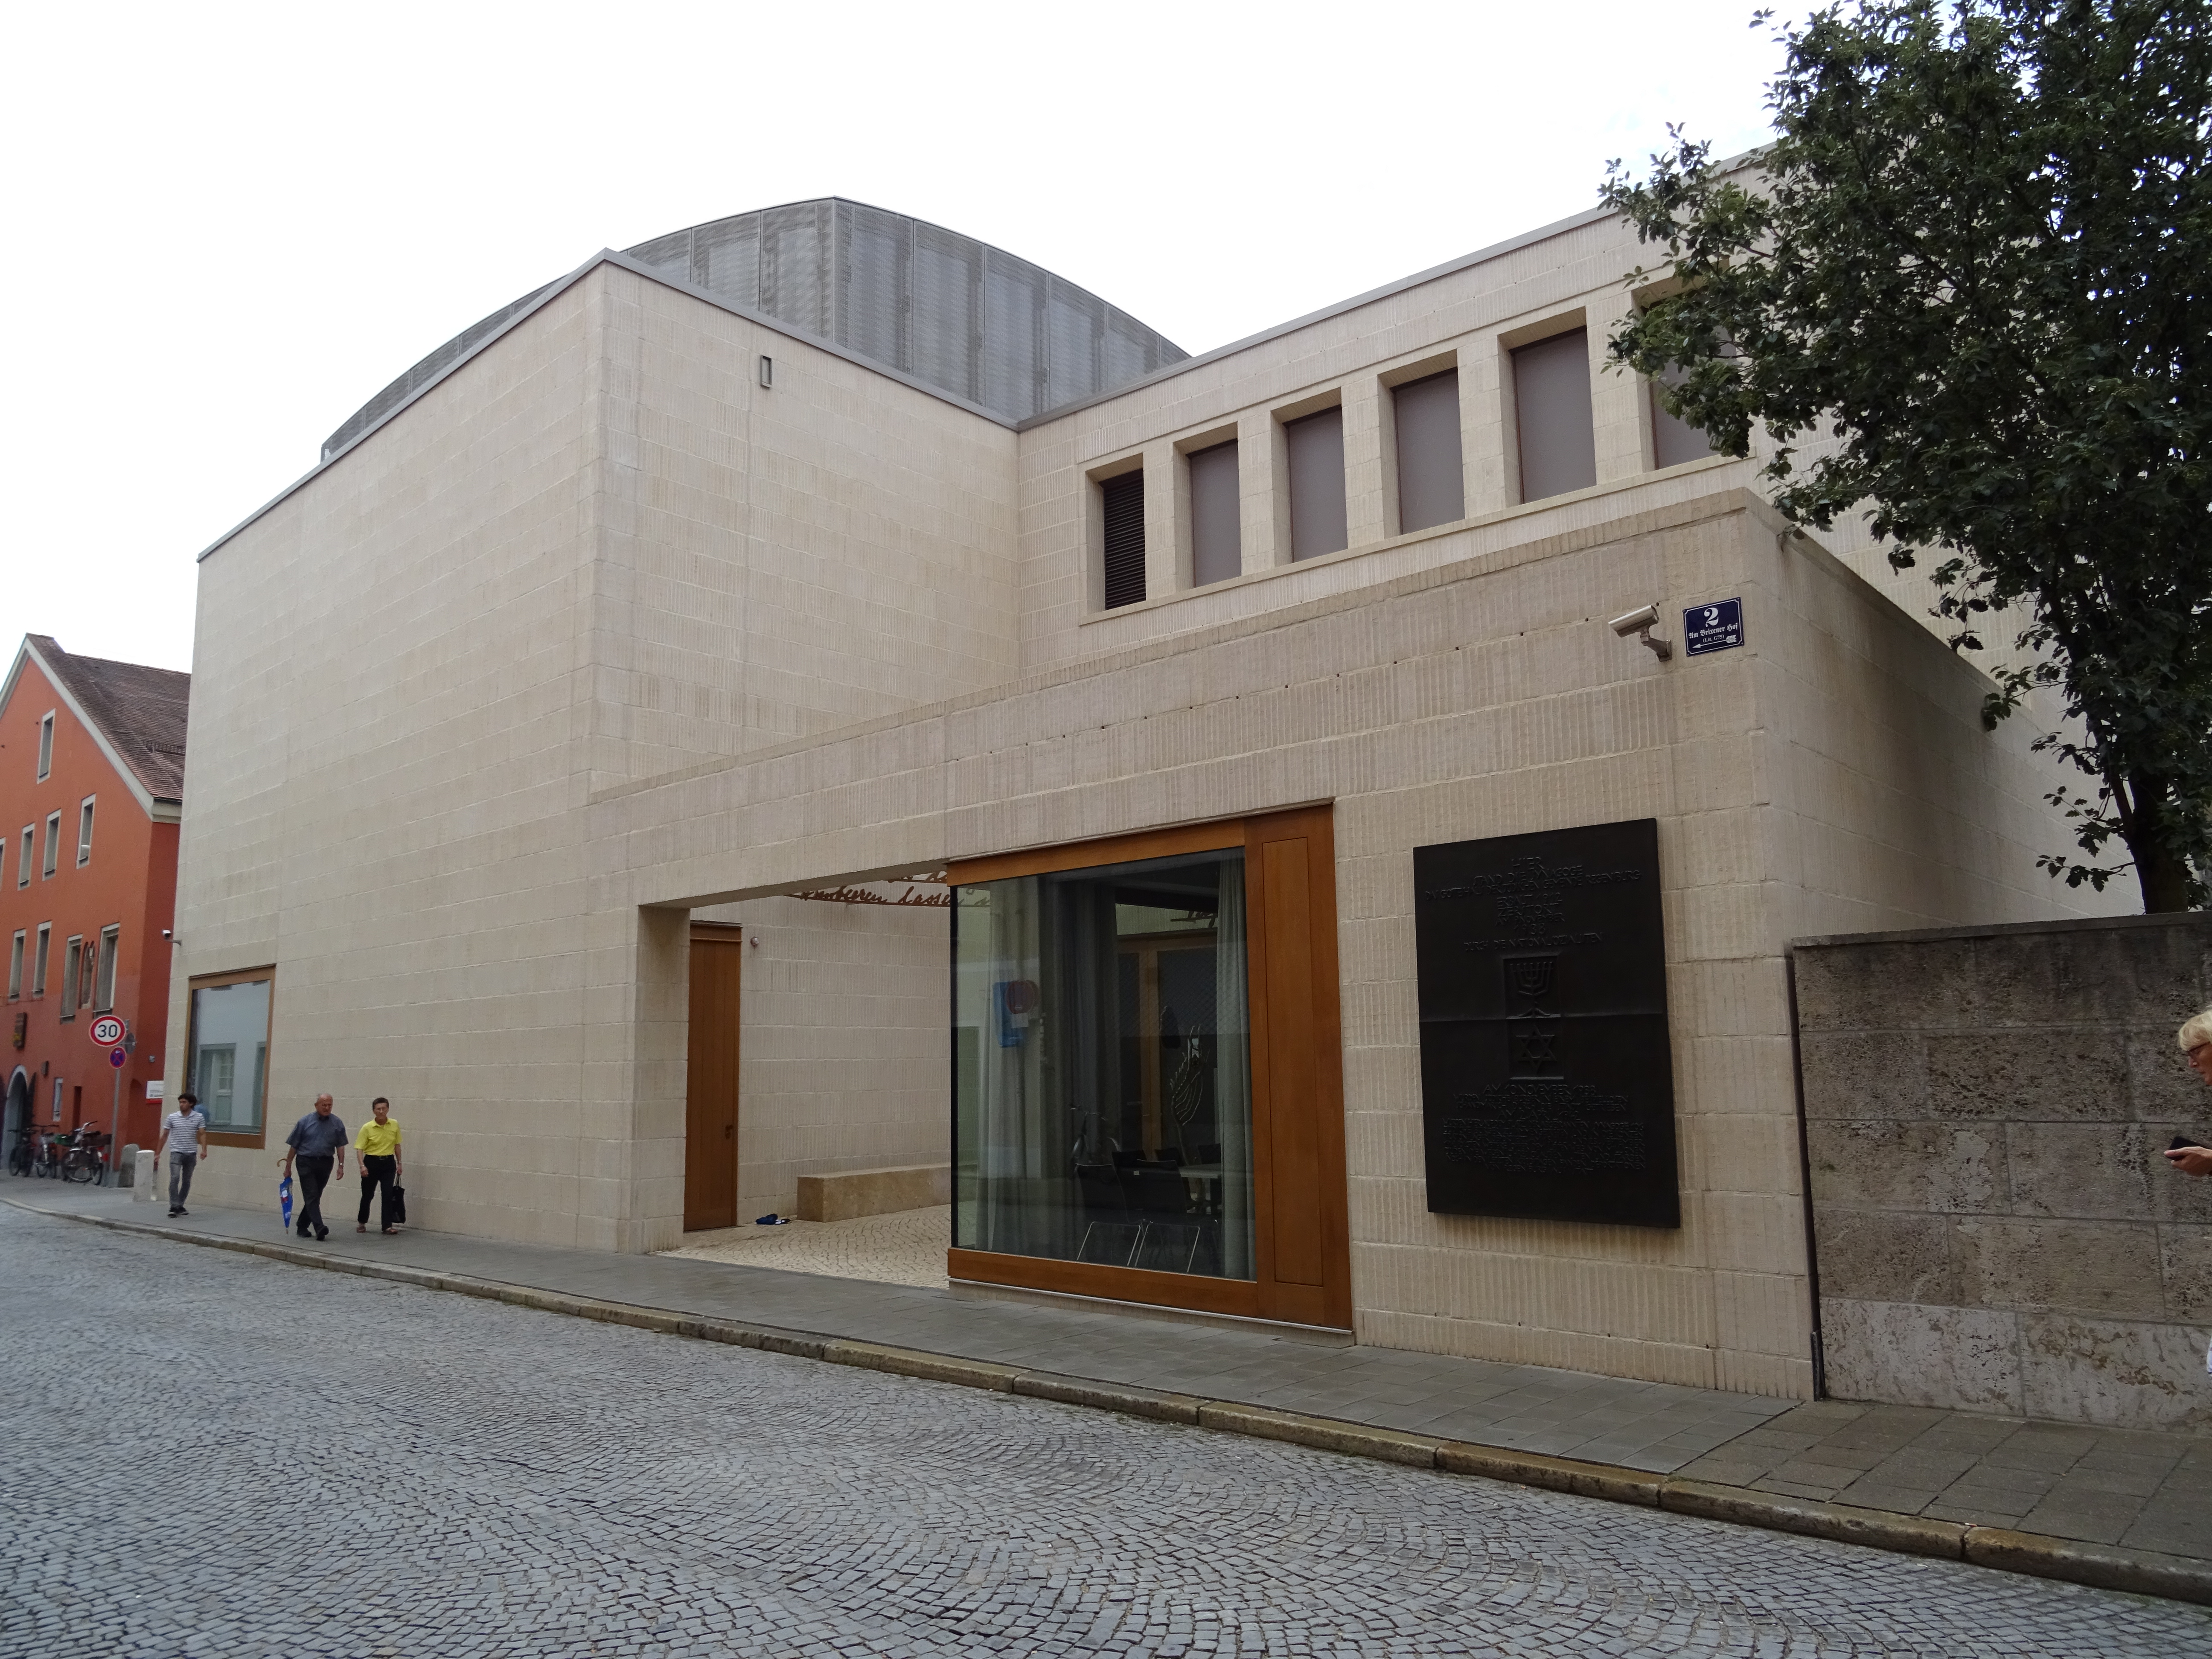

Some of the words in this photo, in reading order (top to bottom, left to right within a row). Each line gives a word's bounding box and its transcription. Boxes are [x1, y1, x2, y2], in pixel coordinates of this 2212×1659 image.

[1704, 607, 1719, 627] 2
[1700, 626, 1725, 636] Brixener
[1727, 623, 1738, 631] Hof
[1511, 857, 1545, 870] HIER
[1473, 874, 1502, 886] STAND
[1508, 872, 1526, 882] DIE
[1513, 923, 1545, 935] 1938
[97, 1025, 117, 1037] 30
